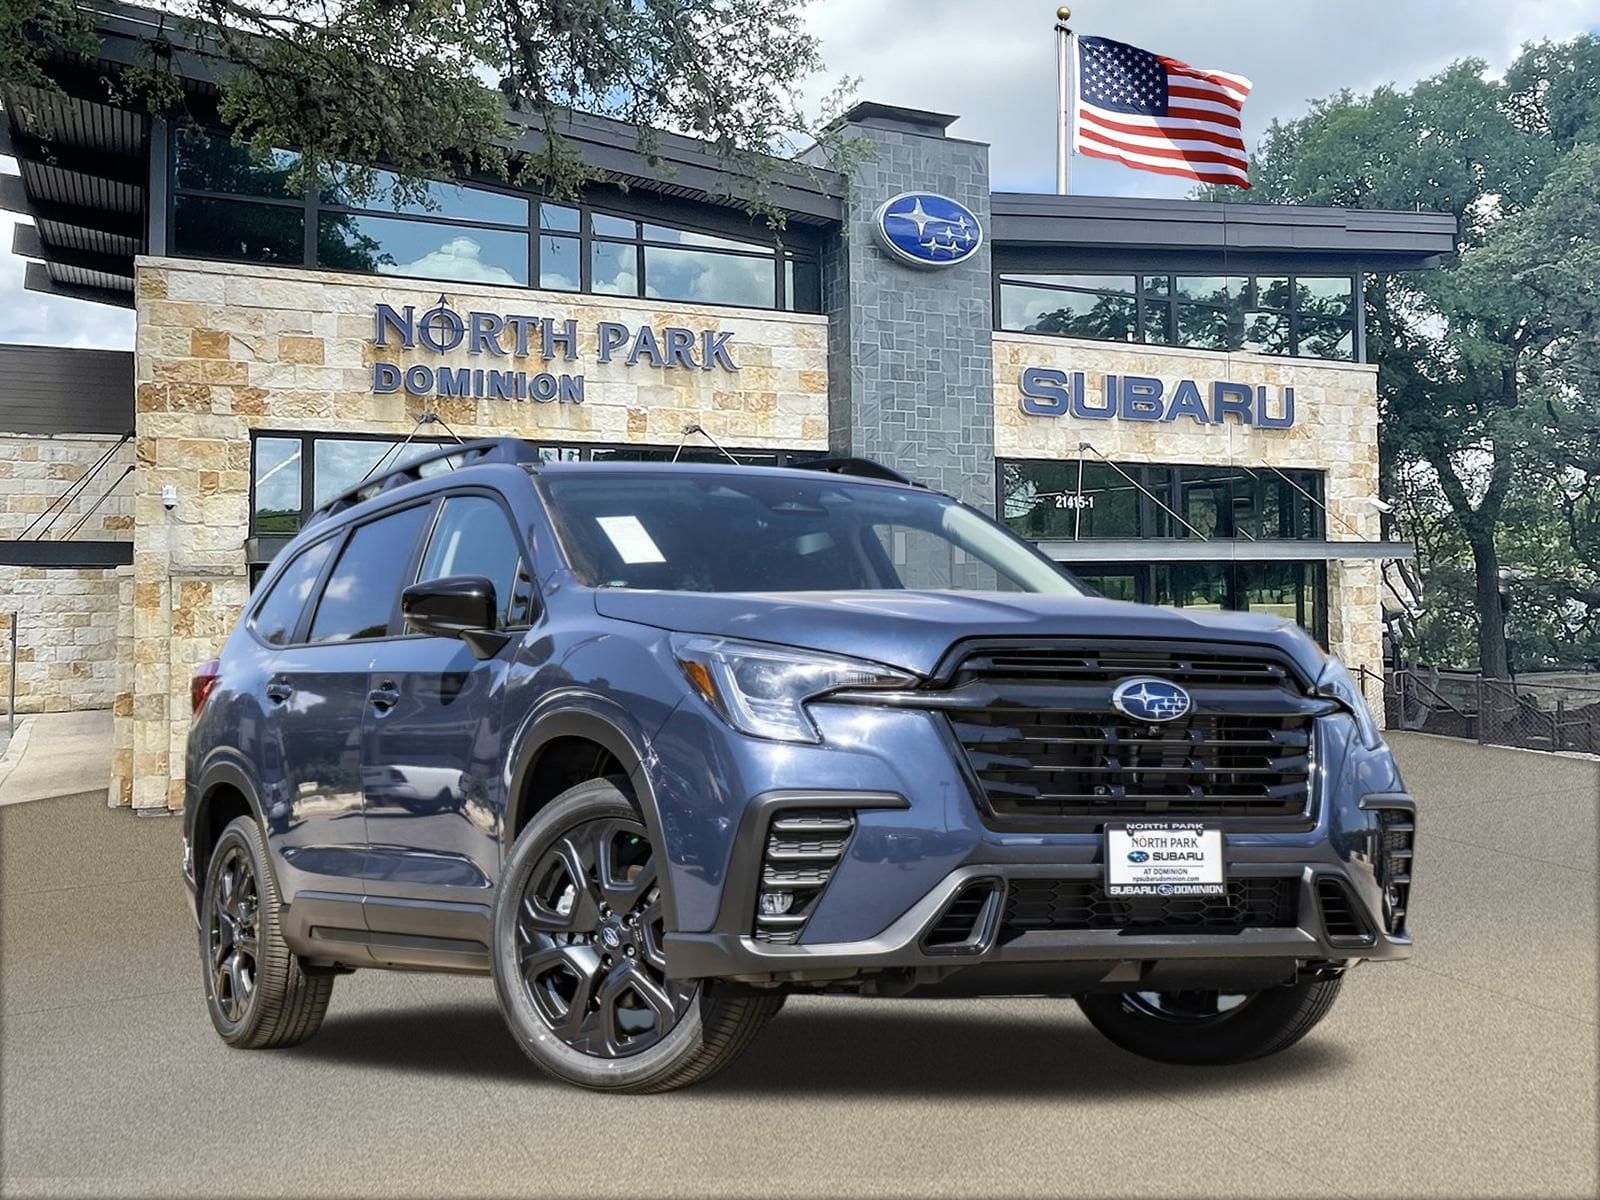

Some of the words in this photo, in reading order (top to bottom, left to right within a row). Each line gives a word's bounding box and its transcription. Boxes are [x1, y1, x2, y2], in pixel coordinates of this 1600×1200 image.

[375, 293, 578, 361] NORTH
[597, 321, 741, 372] PARK
[373, 362, 585, 404] DOMINION
[1019, 367, 1294, 429] SUBARU
[1055, 496, 1094, 508] 21415-1
[1131, 836, 1168, 848] NORTH
[1170, 837, 1199, 848] PARK
[1152, 852, 1204, 860] SUBARU
[1110, 886, 1156, 894] SUBARU
[1174, 884, 1223, 894] DOMINION
